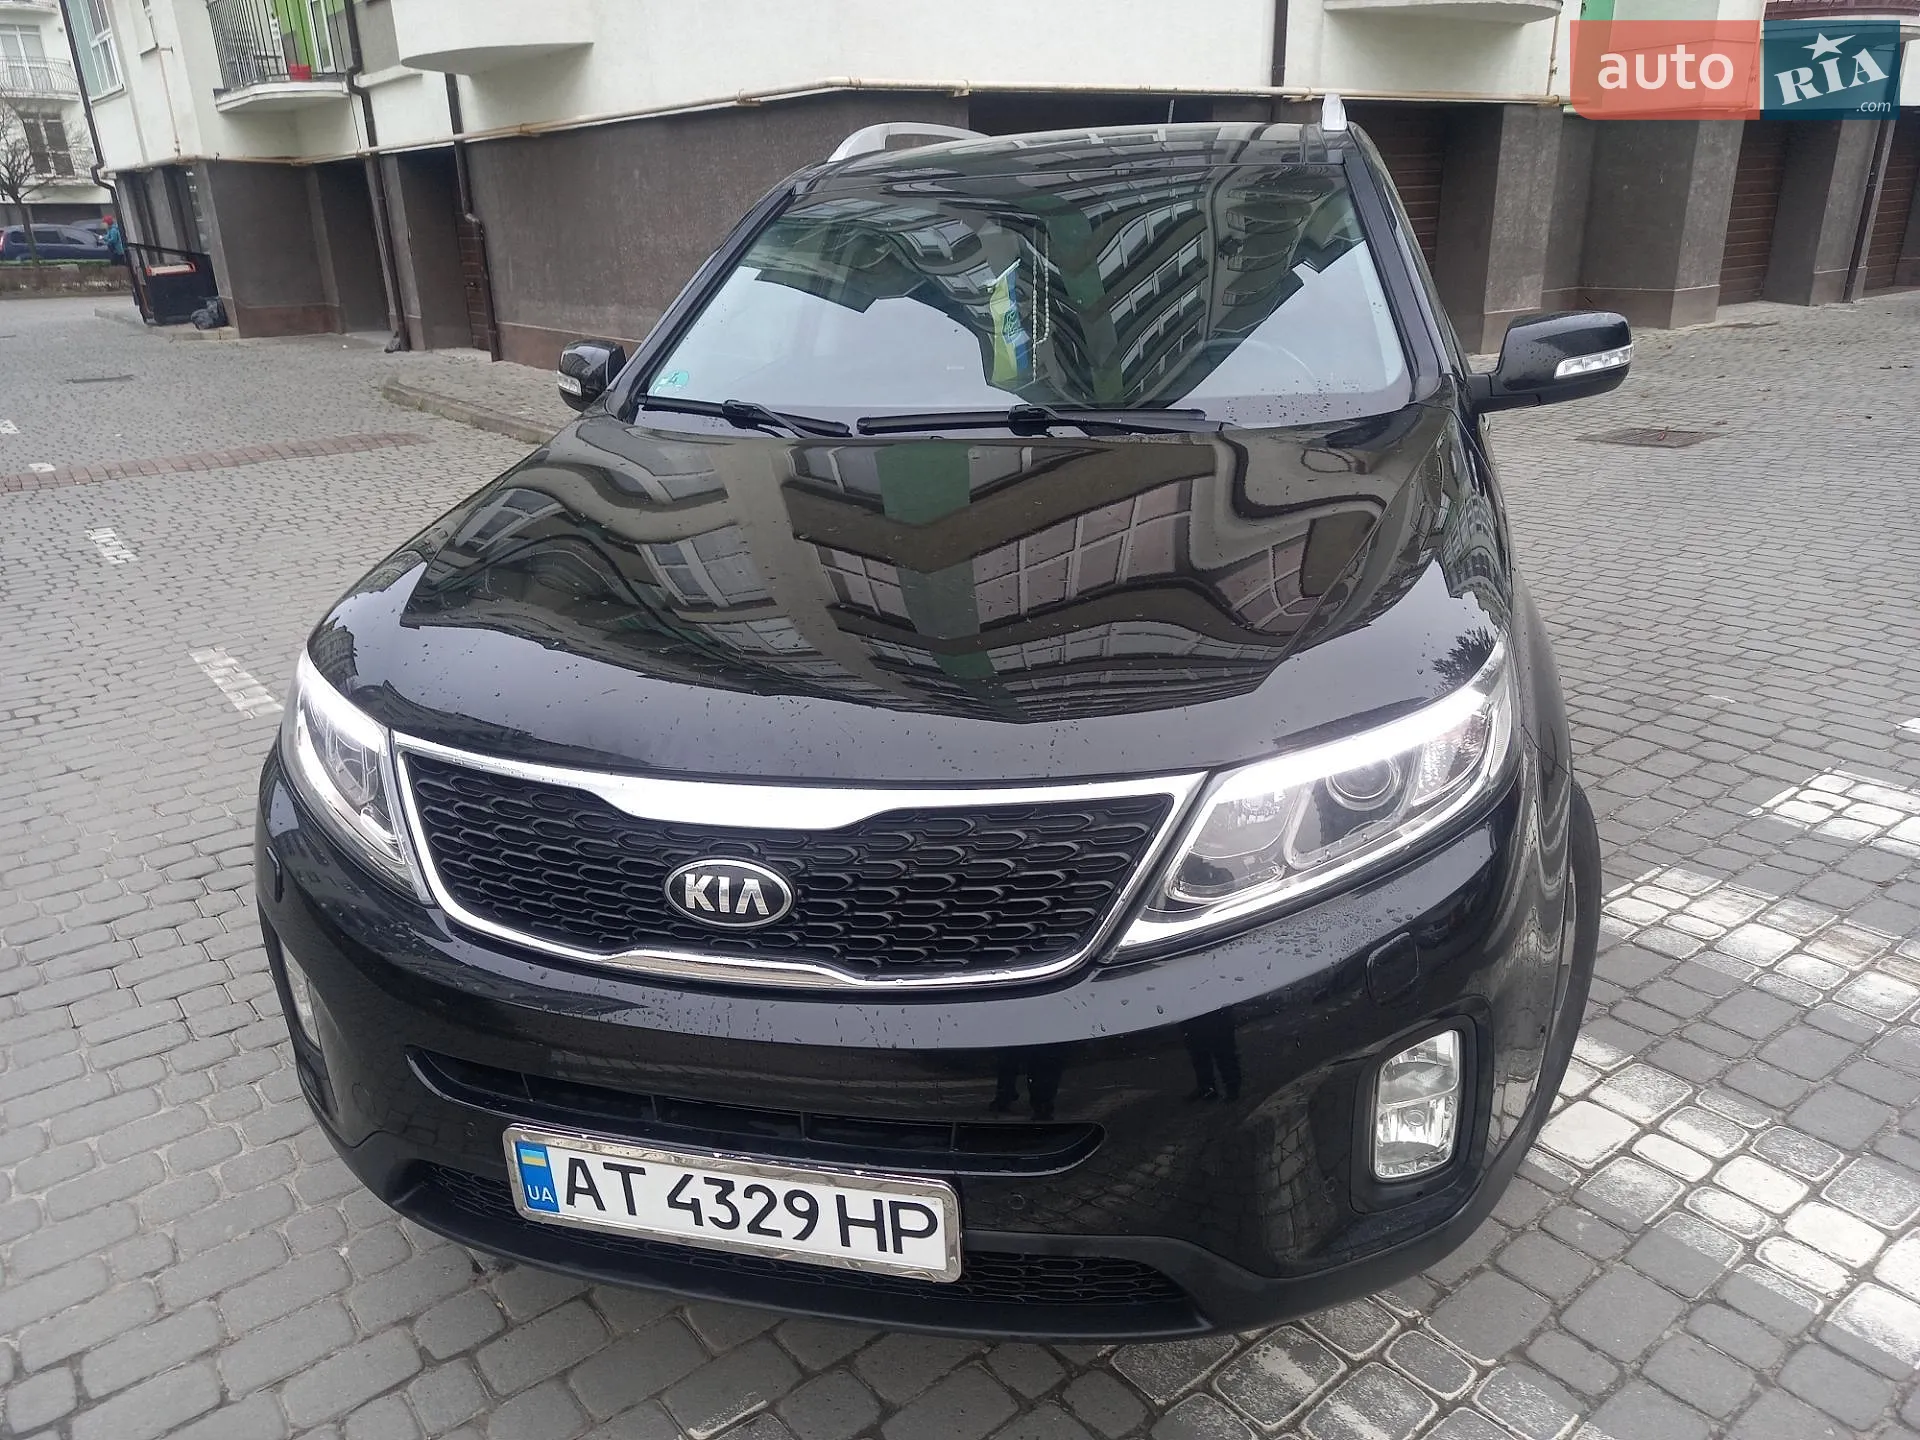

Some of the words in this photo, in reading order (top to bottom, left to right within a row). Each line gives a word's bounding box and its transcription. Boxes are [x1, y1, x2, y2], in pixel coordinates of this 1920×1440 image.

[684, 873, 770, 915] KIA
[527, 1184, 555, 1203] UA
[564, 1157, 647, 1217] AT
[667, 1173, 819, 1240] 4329
[835, 1193, 939, 1255] HP
